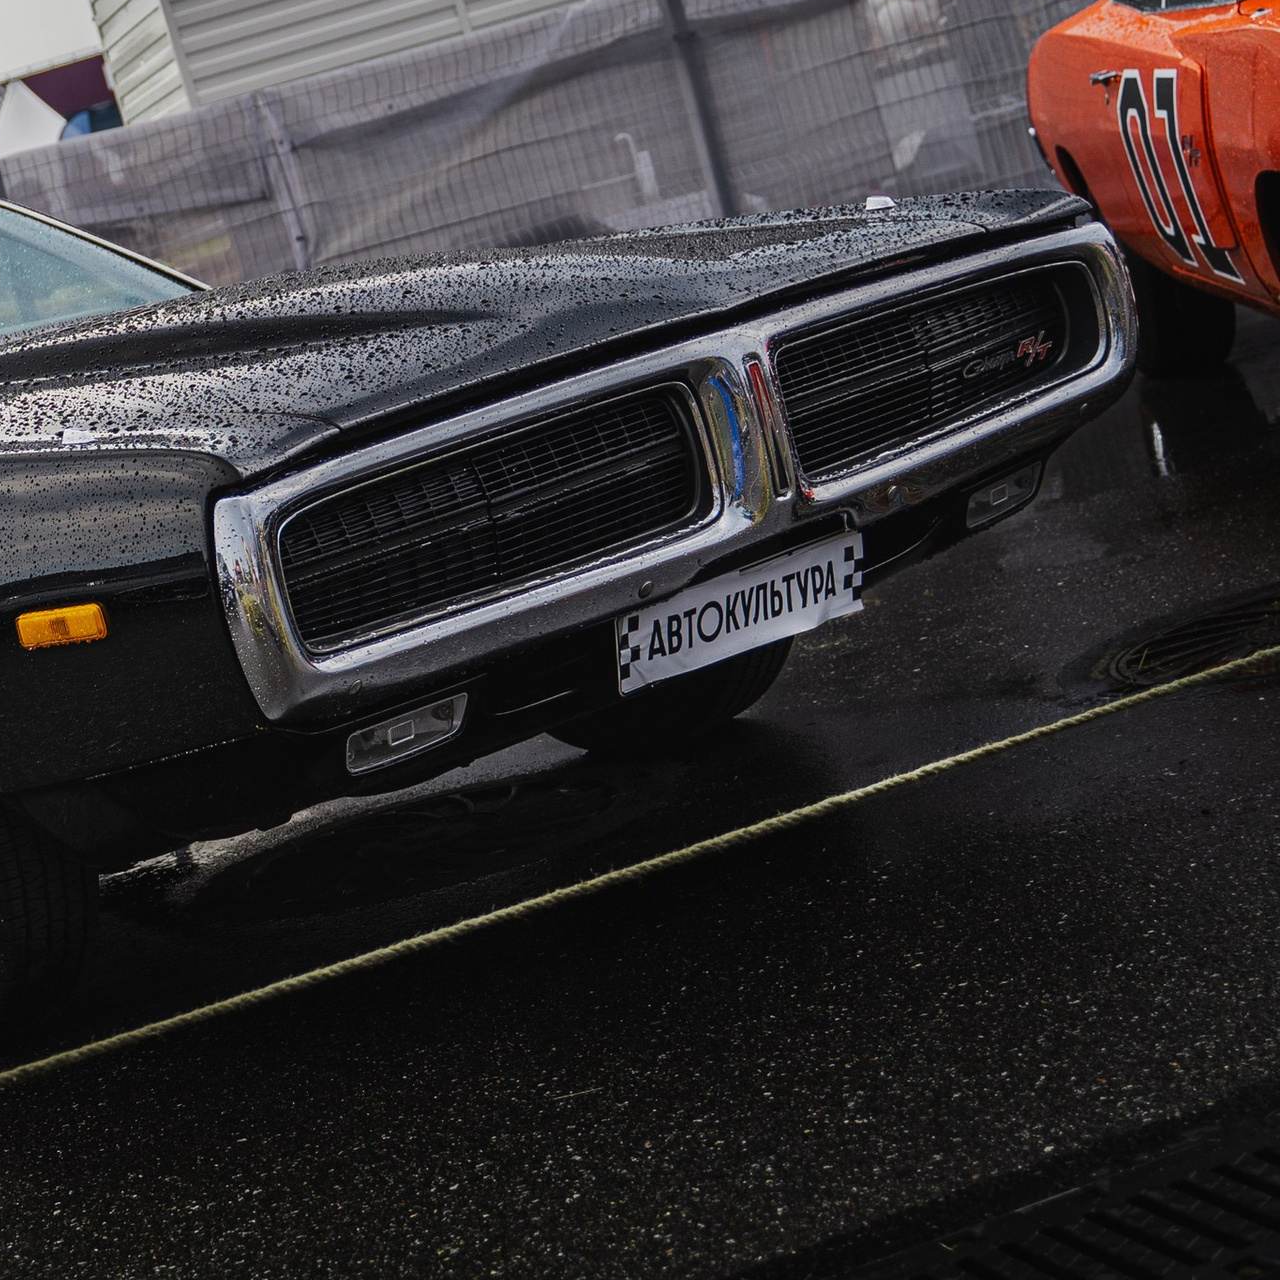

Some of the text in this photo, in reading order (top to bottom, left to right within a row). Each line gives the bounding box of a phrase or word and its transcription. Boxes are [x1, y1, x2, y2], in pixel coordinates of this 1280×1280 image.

[1116, 68, 1247, 285] 01
[1017, 330, 1053, 367] R/T
[647, 560, 838, 661] АВТОКУЛЬТУРА
